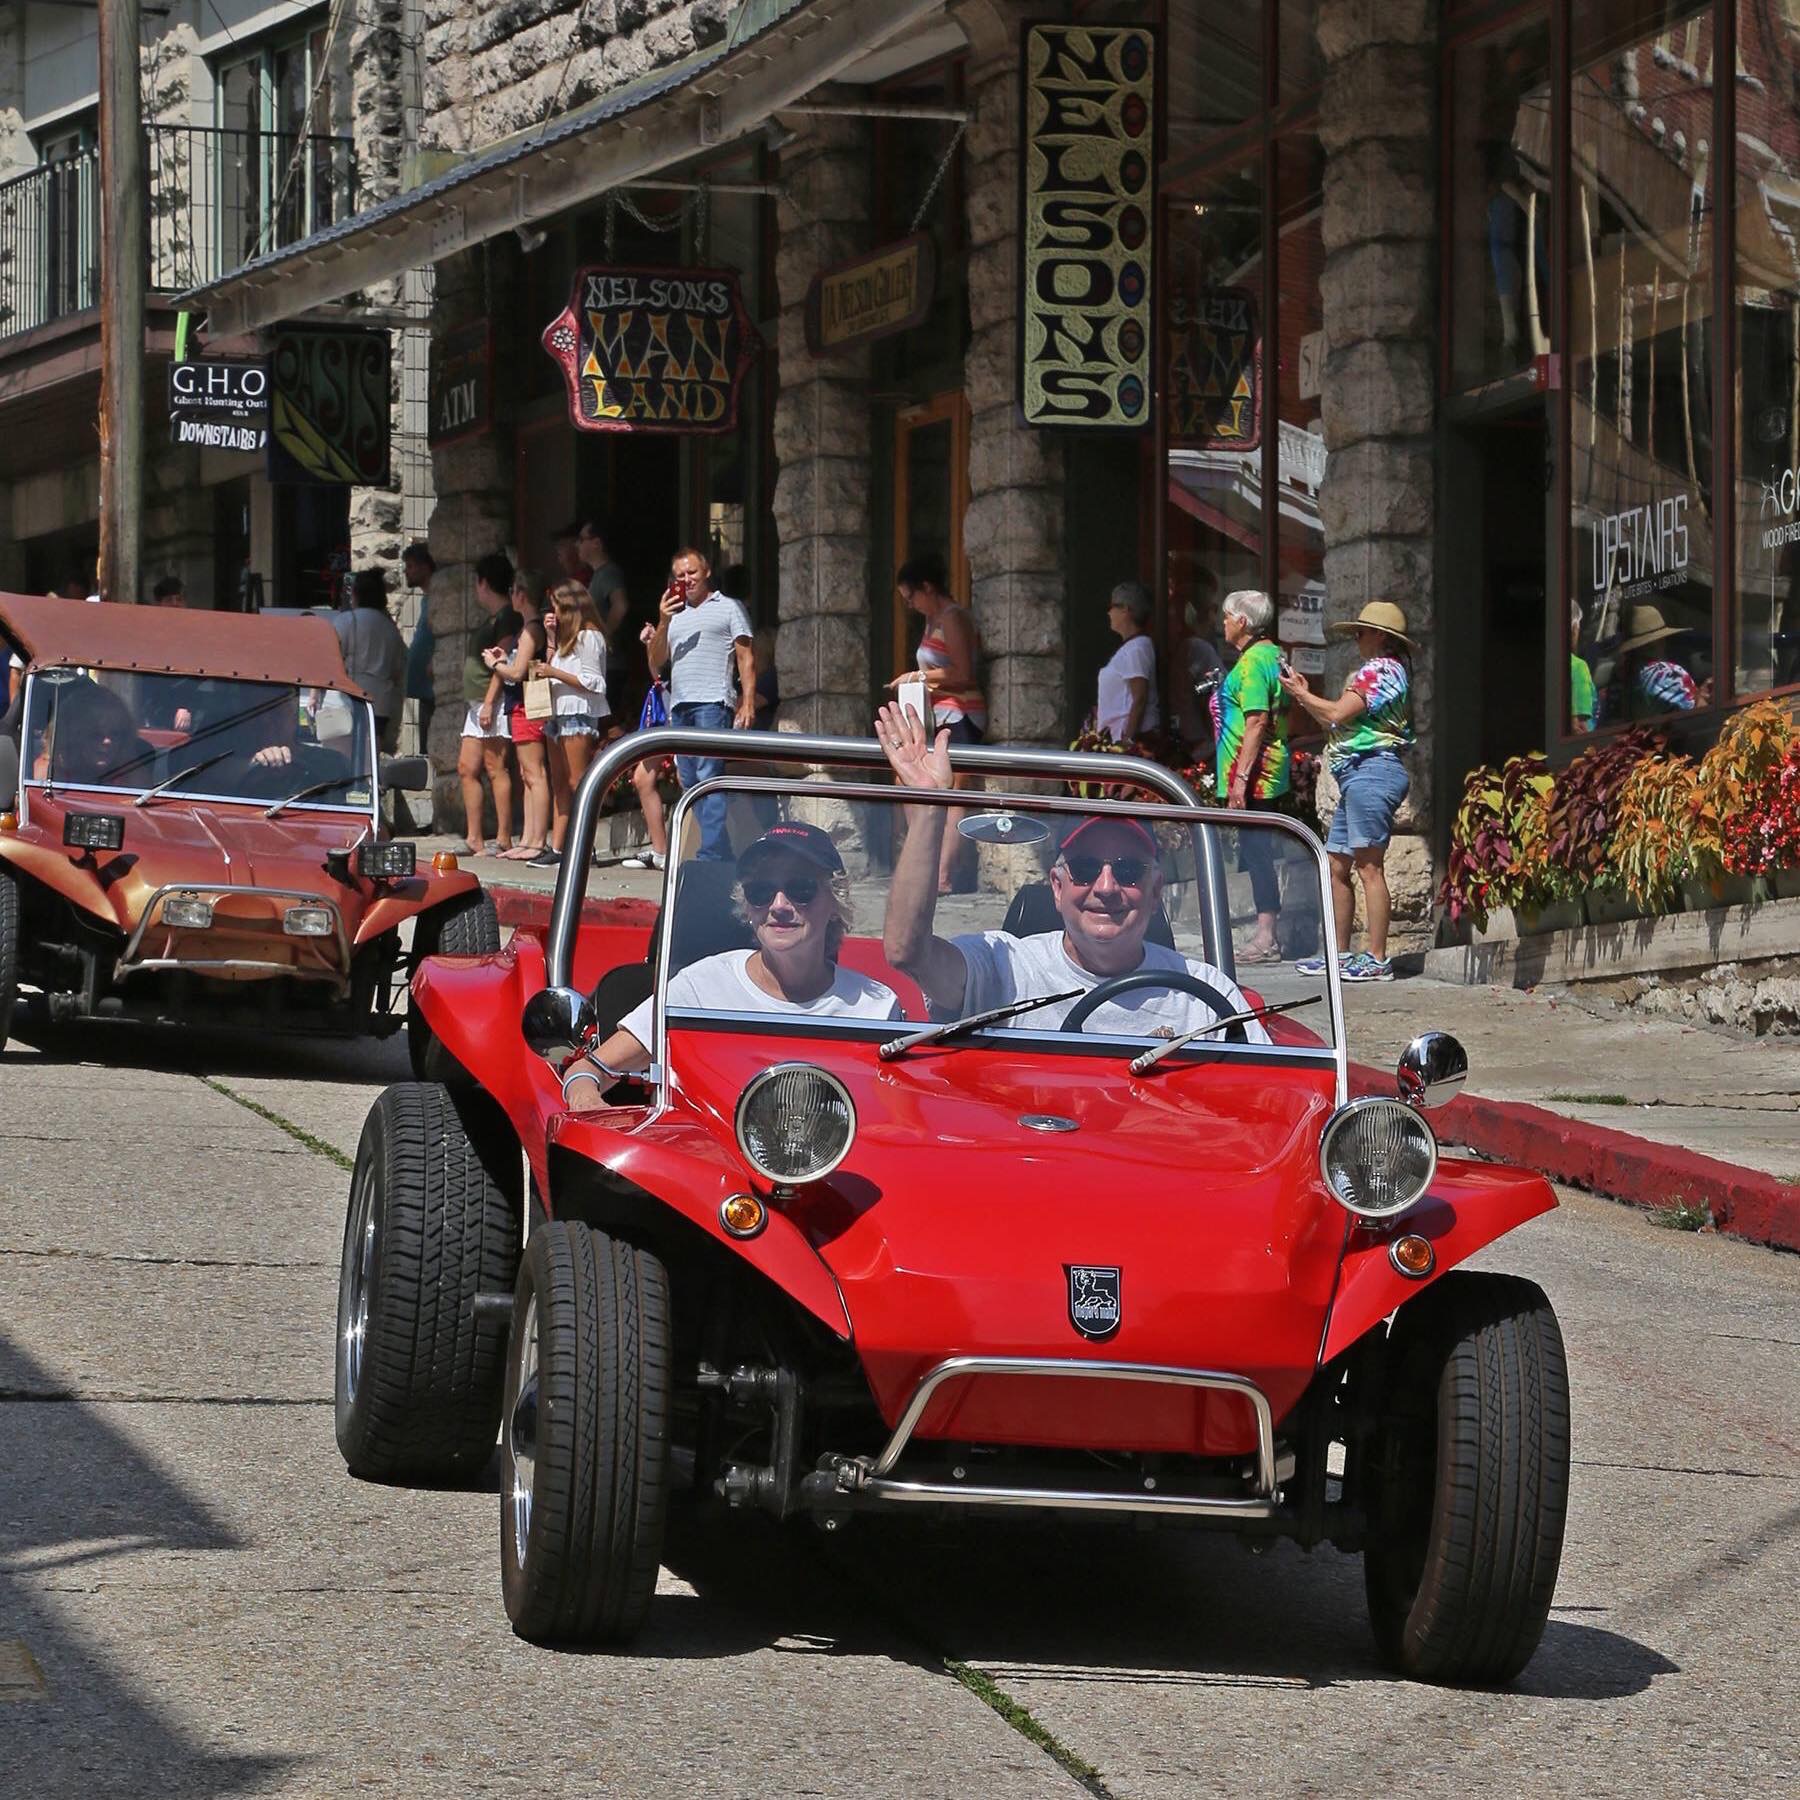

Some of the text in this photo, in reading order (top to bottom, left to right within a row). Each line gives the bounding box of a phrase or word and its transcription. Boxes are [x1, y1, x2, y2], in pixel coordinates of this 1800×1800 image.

[1033, 30, 1121, 419] NELSONS
[585, 275, 729, 315] NELSONS
[582, 310, 733, 384] MAN
[204, 396, 244, 409] Hunting
[439, 378, 476, 432] ATM
[592, 379, 726, 422] LAND
[1593, 494, 1688, 590] UPSTAIRS
[1761, 526, 1784, 550] WOOD
